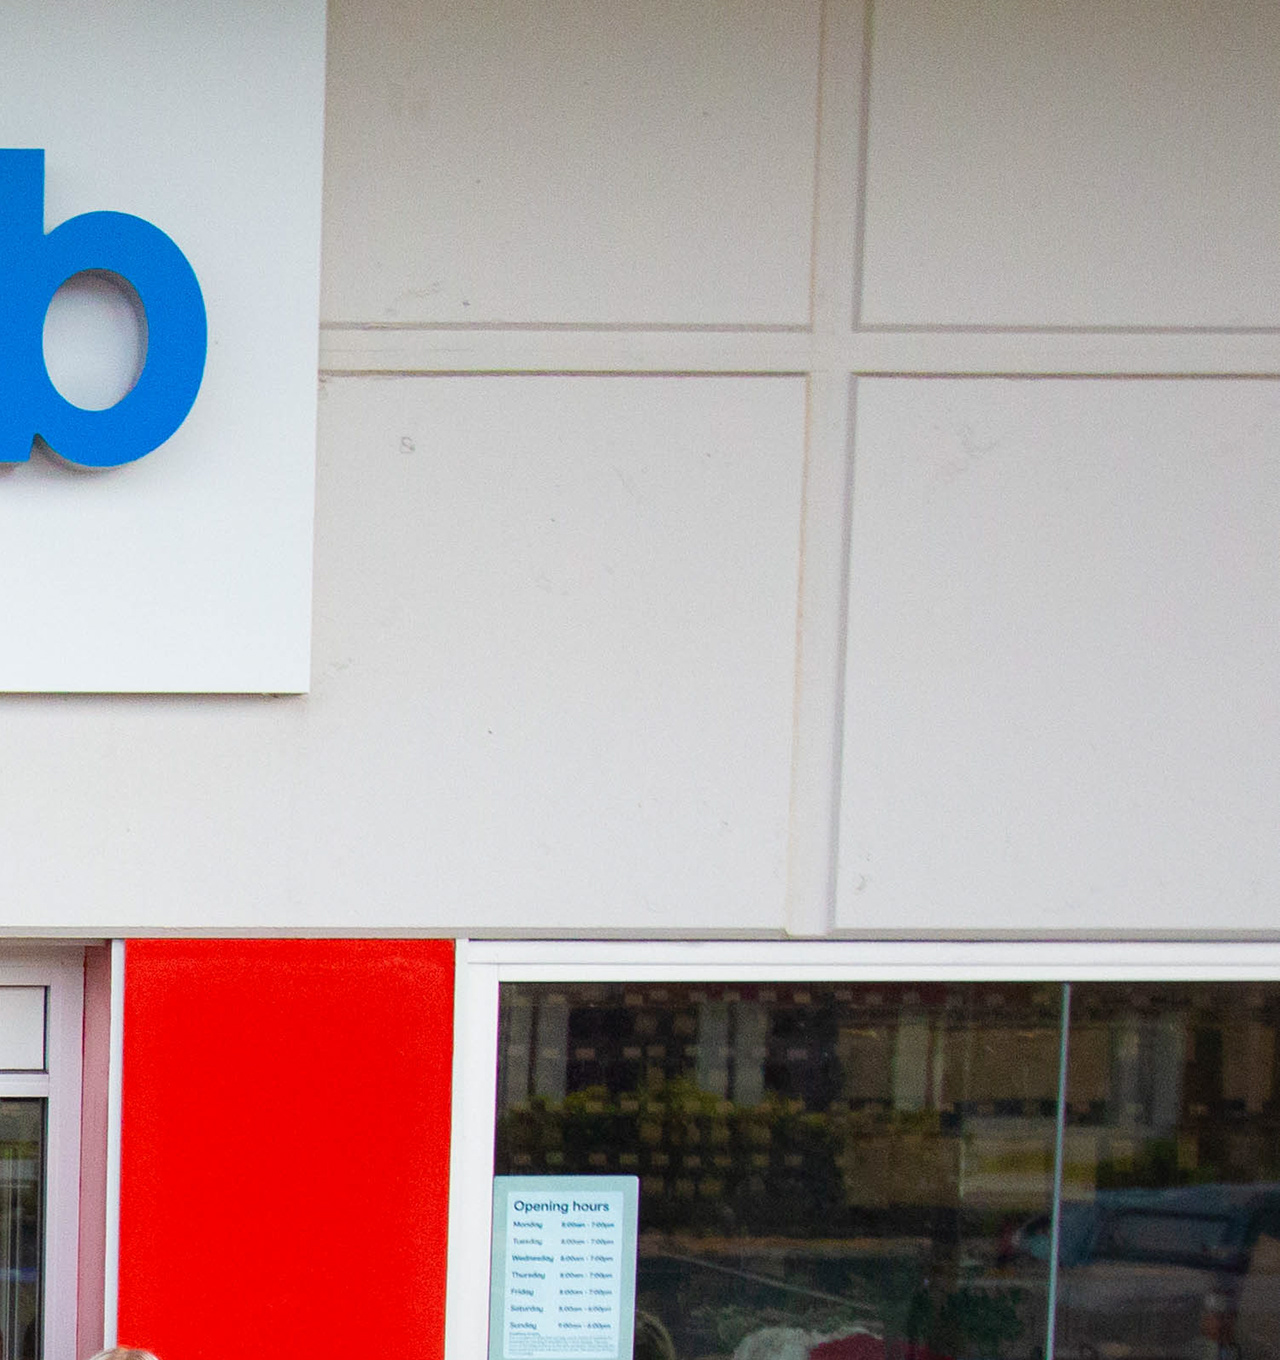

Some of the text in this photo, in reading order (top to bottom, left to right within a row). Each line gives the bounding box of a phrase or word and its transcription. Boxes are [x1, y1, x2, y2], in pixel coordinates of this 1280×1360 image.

[514, 1200, 609, 1214] Opening hours
[513, 1221, 543, 1229] Monday
[510, 1322, 537, 1330] Sunday
